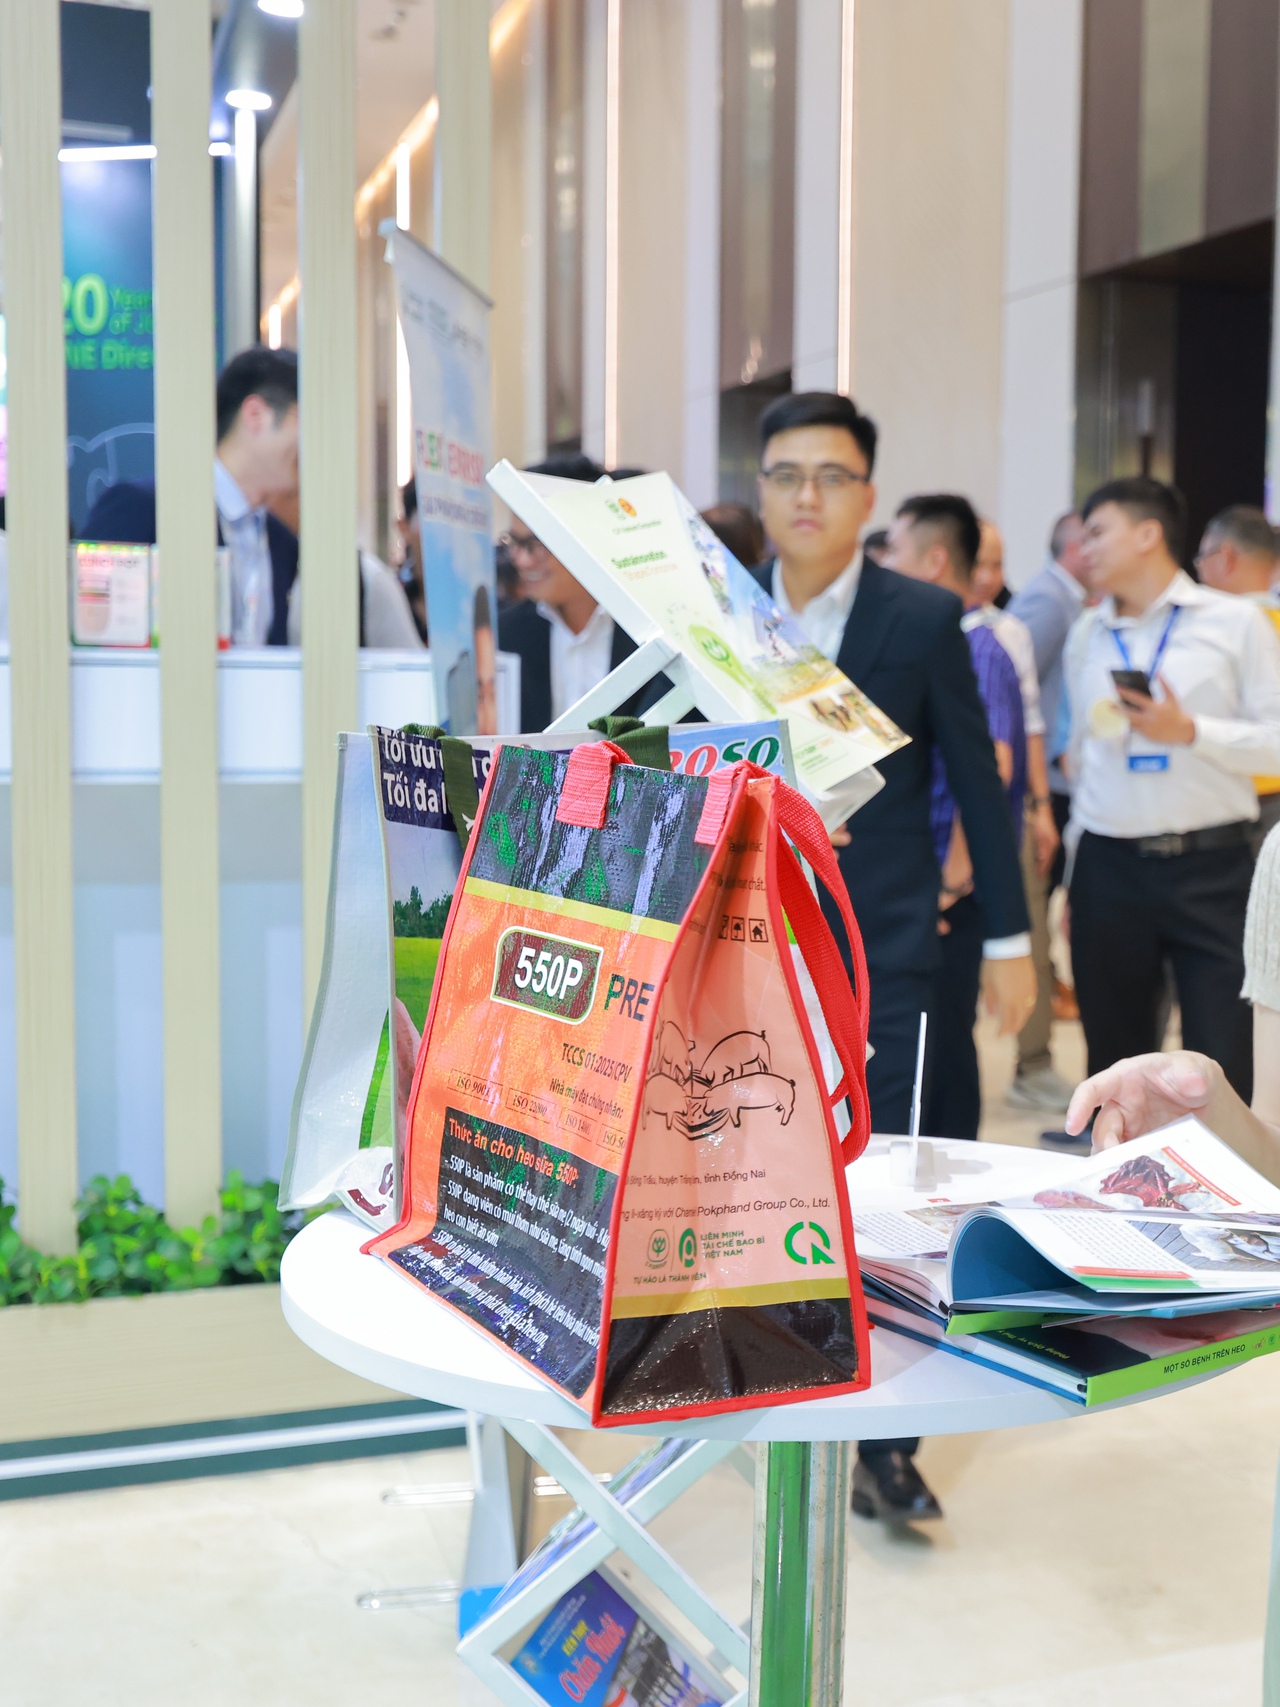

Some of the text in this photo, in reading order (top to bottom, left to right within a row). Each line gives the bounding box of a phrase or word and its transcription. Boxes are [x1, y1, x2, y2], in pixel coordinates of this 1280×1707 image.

[101, 338, 153, 370] Dire
[381, 727, 407, 764] Tối
[410, 739, 436, 770] ưu
[383, 771, 411, 808] Tối
[414, 779, 439, 813] đa
[514, 946, 583, 1000] 550P
[604, 974, 655, 1021] PRE
[561, 1043, 584, 1066] TCCS
[456, 1076, 471, 1090] ISO
[550, 1078, 564, 1095] Nhà
[512, 1095, 528, 1109] ISO
[565, 1114, 578, 1129] ISO
[449, 1118, 472, 1144] Thức
[474, 1129, 488, 1150] ăn
[490, 1138, 514, 1159] cho
[516, 1144, 535, 1167] heo
[535, 1154, 554, 1178] sữa
[602, 1131, 616, 1146] ISO
[449, 1154, 465, 1175] 550P
[465, 1161, 472, 1178] là
[472, 1165, 484, 1183] sản
[484, 1171, 505, 1192] phẩm
[505, 1181, 515, 1196] có
[704, 1173, 721, 1184] tỉnh
[723, 1170, 748, 1182] Đồng
[750, 1169, 766, 1179] Nai
[447, 1180, 463, 1199] 550P
[463, 1188, 480, 1211] dạng
[493, 1204, 502, 1218] có
[698, 1202, 750, 1217] Pokphand
[753, 1200, 787, 1213] Group
[789, 1197, 811, 1210] Co.,
[813, 1197, 830, 1208] Ltd.
[444, 1203, 455, 1222] heo
[455, 1214, 467, 1229] con
[701, 1230, 744, 1241] LIÊN MINH
[717, 1238, 734, 1248] CHẾ
[736, 1238, 754, 1246] BAO
[756, 1235, 765, 1244] BÌ
[723, 1249, 743, 1257] NAM
[1164, 1363, 1179, 1374] MỘT
[1180, 1359, 1191, 1369] SỐ
[1191, 1355, 1211, 1367] BỆNH
[1212, 1348, 1230, 1360] TRÊN
[1231, 1344, 1246, 1355] HEO
